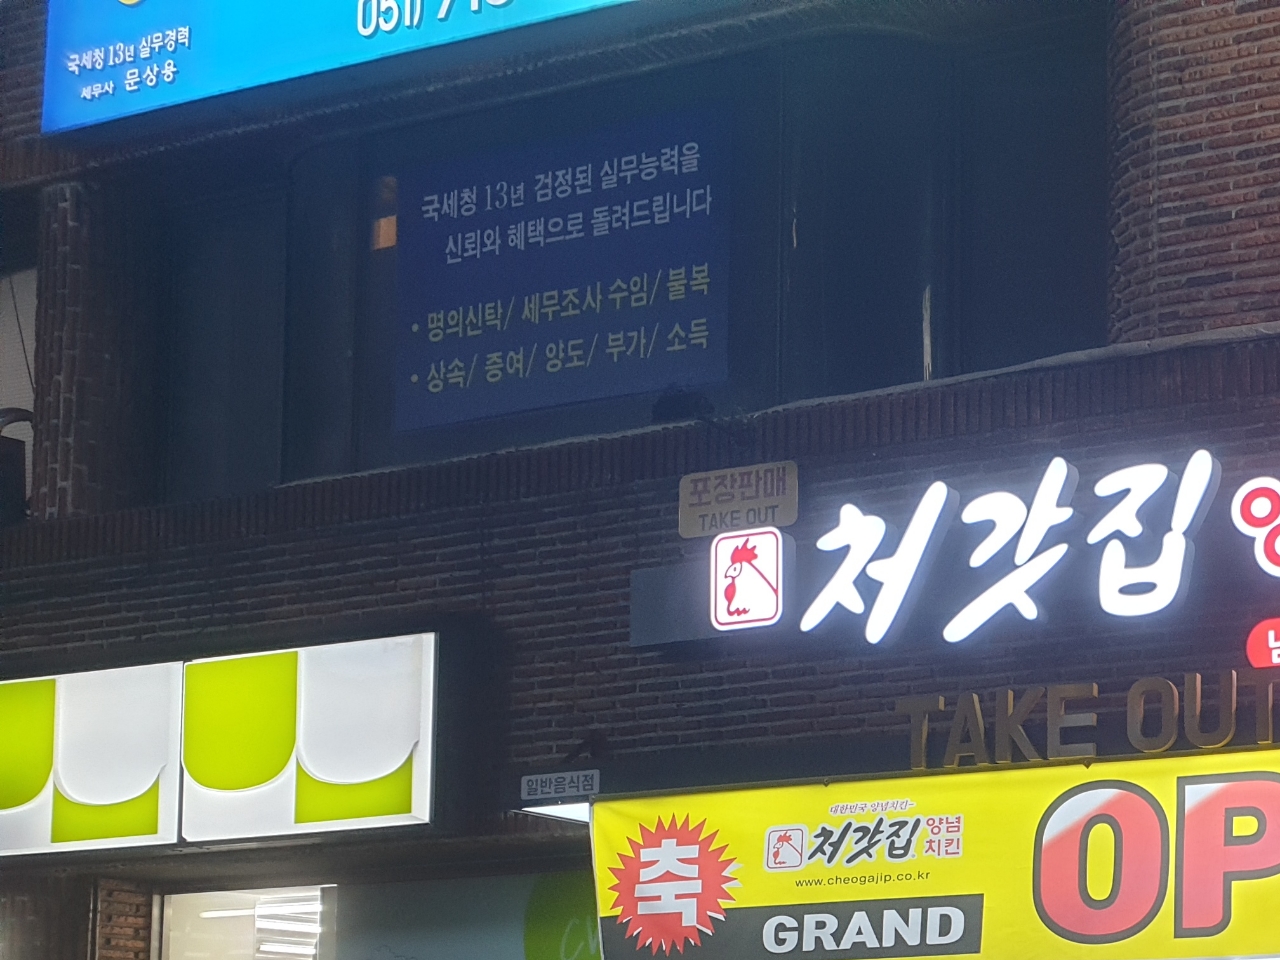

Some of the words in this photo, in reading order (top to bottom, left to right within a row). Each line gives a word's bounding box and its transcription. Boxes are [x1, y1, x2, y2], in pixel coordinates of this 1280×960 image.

[67, 47, 104, 74] 국세청
[108, 43, 135, 66] 13년
[139, 26, 189, 58] 실무경력
[80, 80, 114, 99] 세무사
[124, 59, 177, 91] 문상용
[422, 186, 477, 222] 국세청
[485, 181, 525, 211] 13년
[534, 164, 592, 202] 검정된
[600, 142, 700, 189] 실무능력을
[445, 226, 501, 264] 신뢰와
[507, 211, 585, 250] 혜택으로
[591, 185, 712, 238] 돌려드립니다
[427, 295, 515, 343] 명의신탁/
[521, 281, 601, 325] 세무조사
[666, 262, 711, 301] 불복
[426, 354, 478, 394] 상속/
[545, 333, 598, 373] 양도/
[606, 322, 659, 362] 부가/
[666, 318, 709, 353] 소득
[688, 466, 786, 508] 포장판매
[699, 509, 740, 531] TAKE
[746, 505, 779, 524] OUT
[799, 450, 1223, 644] 처갓집
[895, 682, 1098, 770] TAKE
[526, 774, 594, 796] 일반음식점
[830, 803, 867, 814] 대한민국
[808, 817, 921, 864] 처갓집
[925, 838, 960, 856] 치킨
[926, 816, 961, 835] 양념
[634, 838, 699, 927] 축
[795, 871, 930, 887] www.cheogajip.co.kr
[762, 906, 965, 954] GRAND
